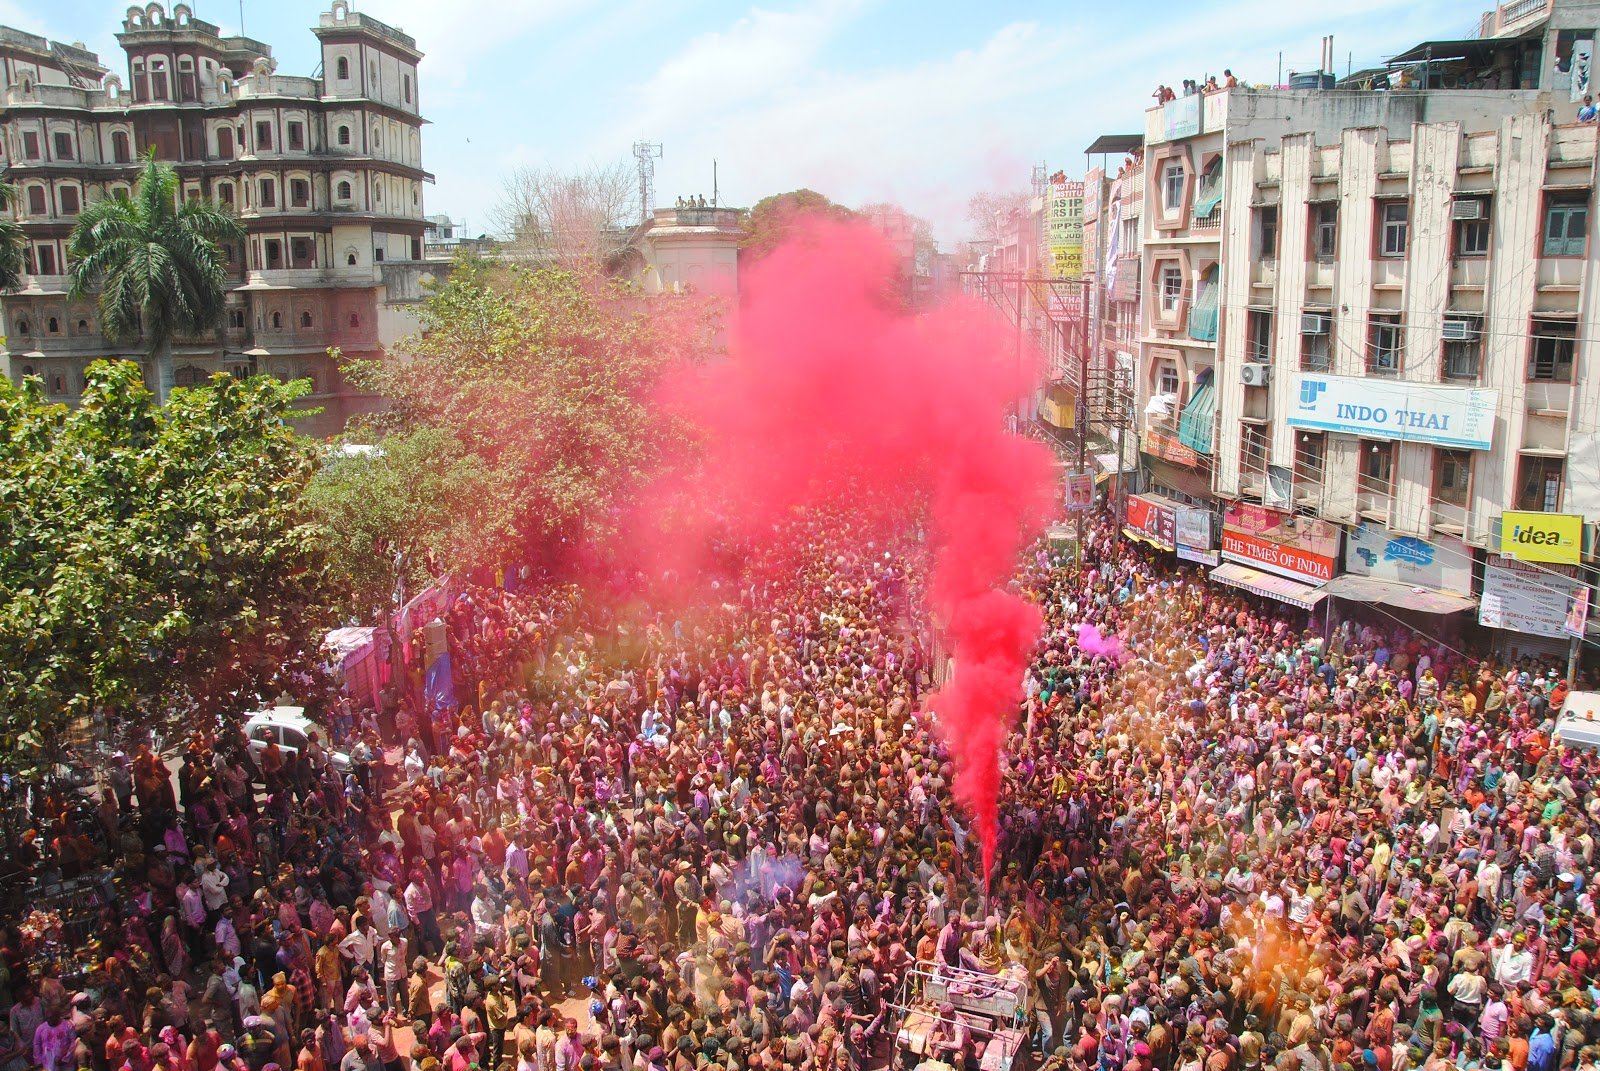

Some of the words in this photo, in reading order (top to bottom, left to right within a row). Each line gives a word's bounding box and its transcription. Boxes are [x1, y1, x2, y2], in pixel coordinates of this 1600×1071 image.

[1051, 199, 1066, 208] IAS
[1051, 209, 1066, 217] IRS
[1336, 403, 1387, 423] INDO
[1395, 410, 1450, 431] THAI
[1512, 525, 1560, 546] idea
[1224, 537, 1244, 553] THE
[1246, 543, 1278, 563] TIMES
[1280, 552, 1296, 567] OF
[1297, 558, 1329, 578] INDIA
[1390, 545, 1427, 557] VISION
